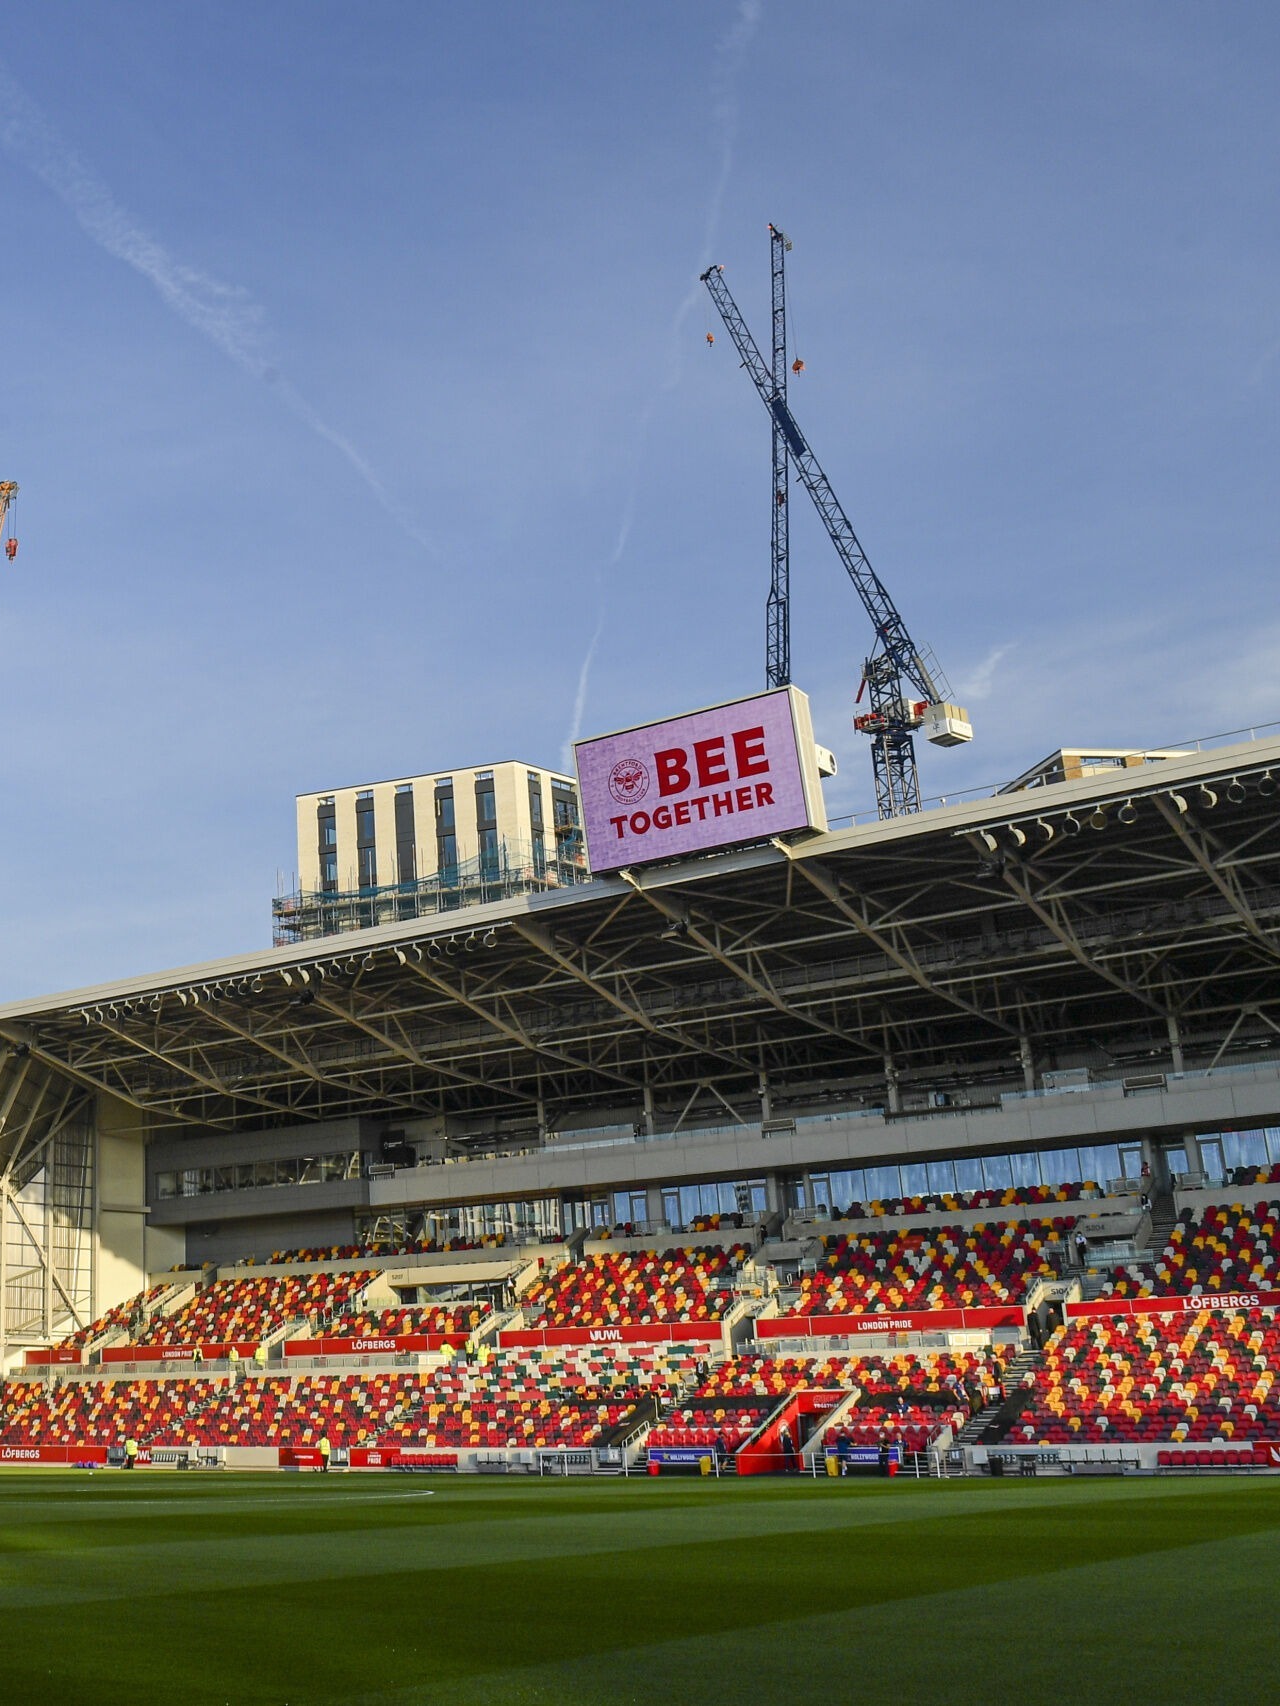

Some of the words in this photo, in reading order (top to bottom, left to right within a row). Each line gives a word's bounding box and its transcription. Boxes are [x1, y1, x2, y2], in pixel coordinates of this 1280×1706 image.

[654, 726, 770, 797] BEE
[610, 782, 775, 838] TOGETHER
[1182, 1294, 1260, 1310] LÖFBERGS
[857, 1320, 889, 1331] LONDON
[889, 1319, 913, 1329] PRIDE
[351, 1339, 396, 1350] LÖFBERGS
[1, 1447, 40, 1459] LÖFBERGS
